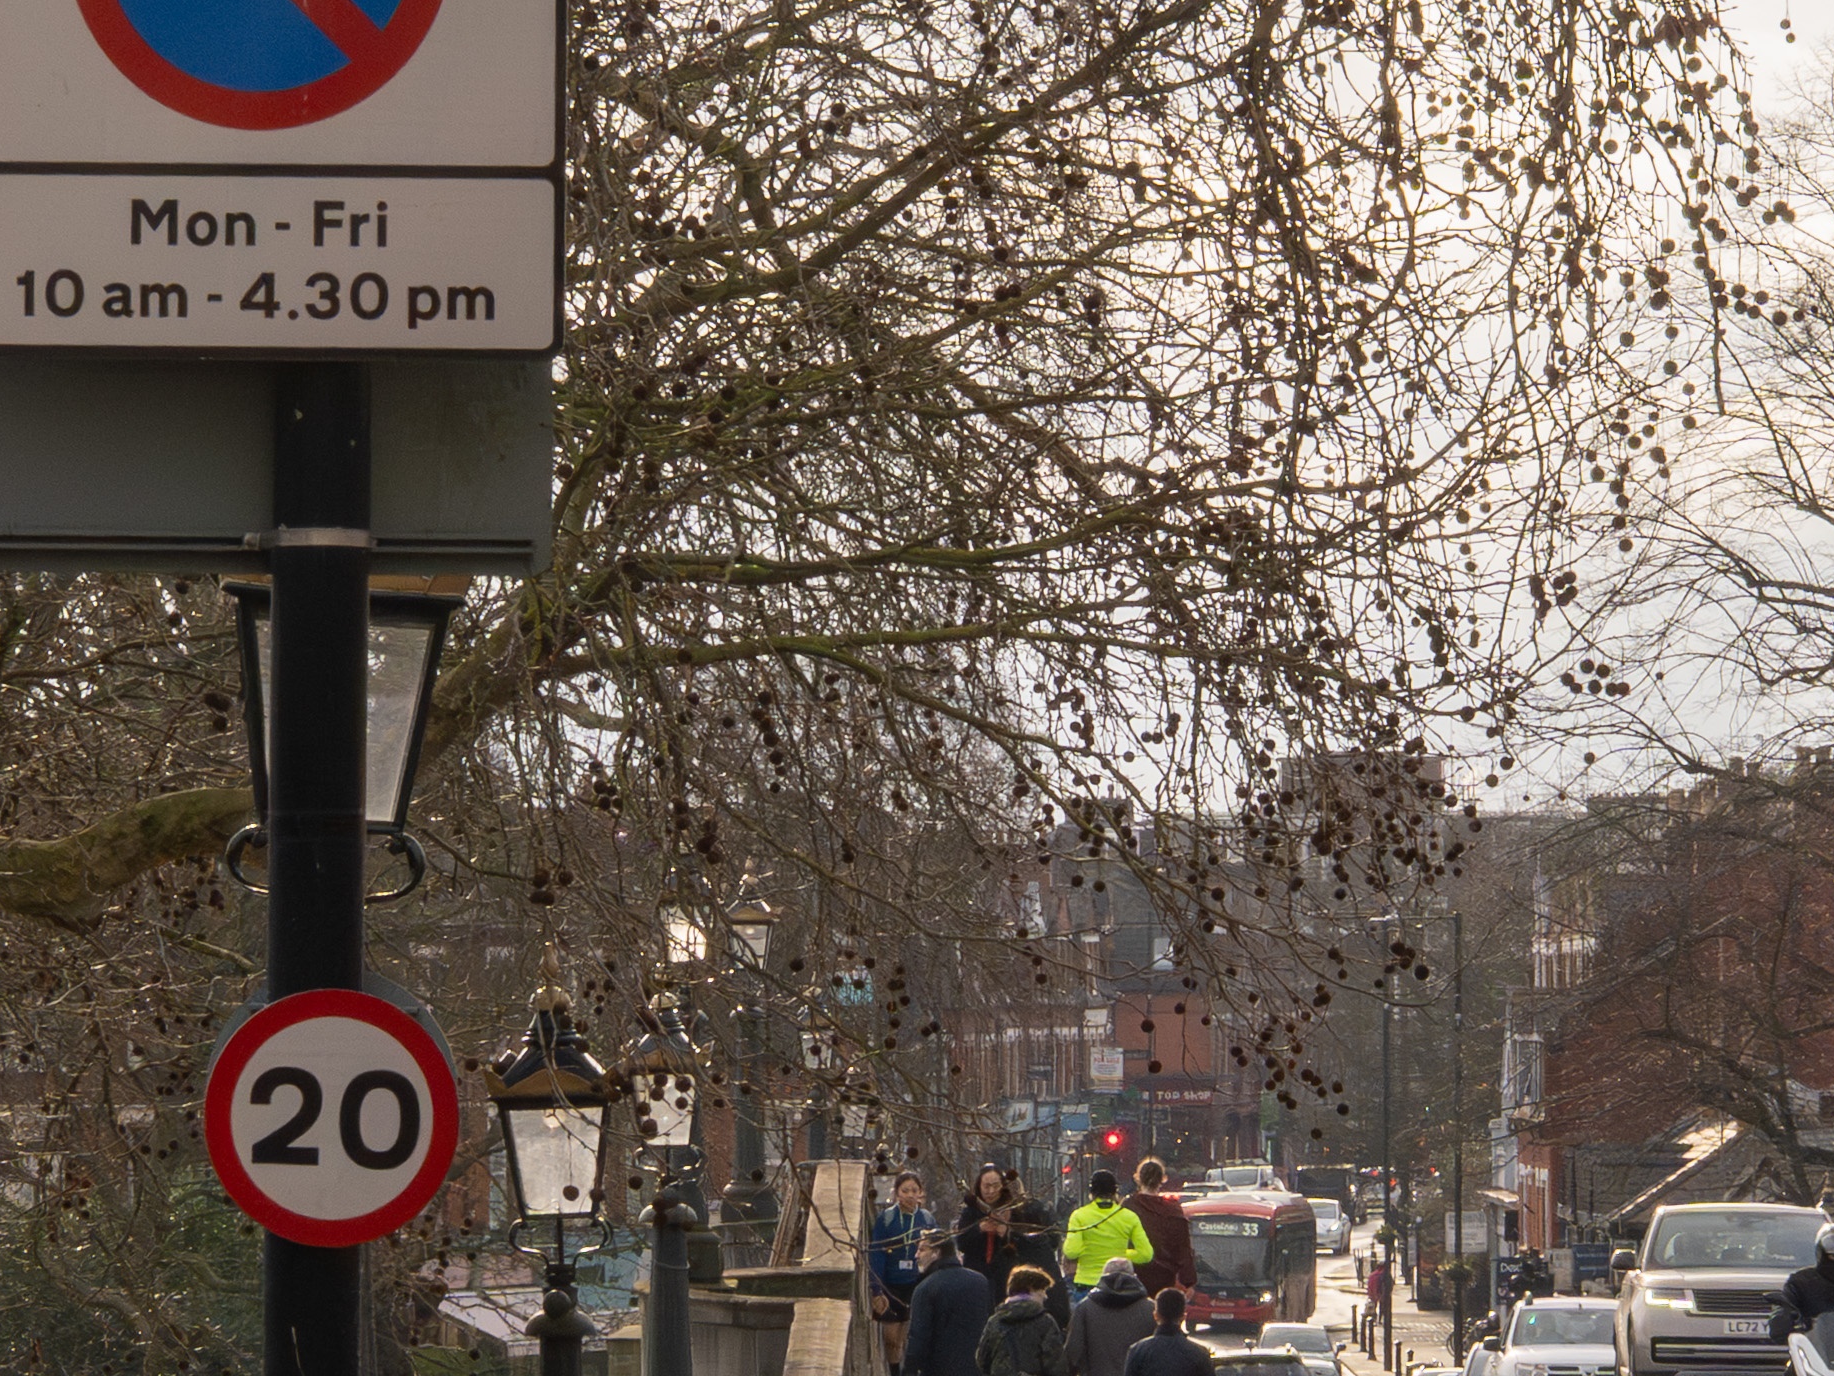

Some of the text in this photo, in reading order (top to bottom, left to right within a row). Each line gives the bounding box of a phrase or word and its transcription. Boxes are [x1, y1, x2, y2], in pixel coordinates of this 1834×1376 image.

[131, 199, 256, 247] Mon
[313, 200, 388, 248] Fri
[16, 269, 84, 317] 10
[102, 281, 188, 317] am
[239, 272, 389, 321] 4.30
[408, 283, 495, 329] pm
[250, 1066, 420, 1170] 20
[1242, 1222, 1260, 1237] 33
[1728, 1320, 1759, 1333] LC72
